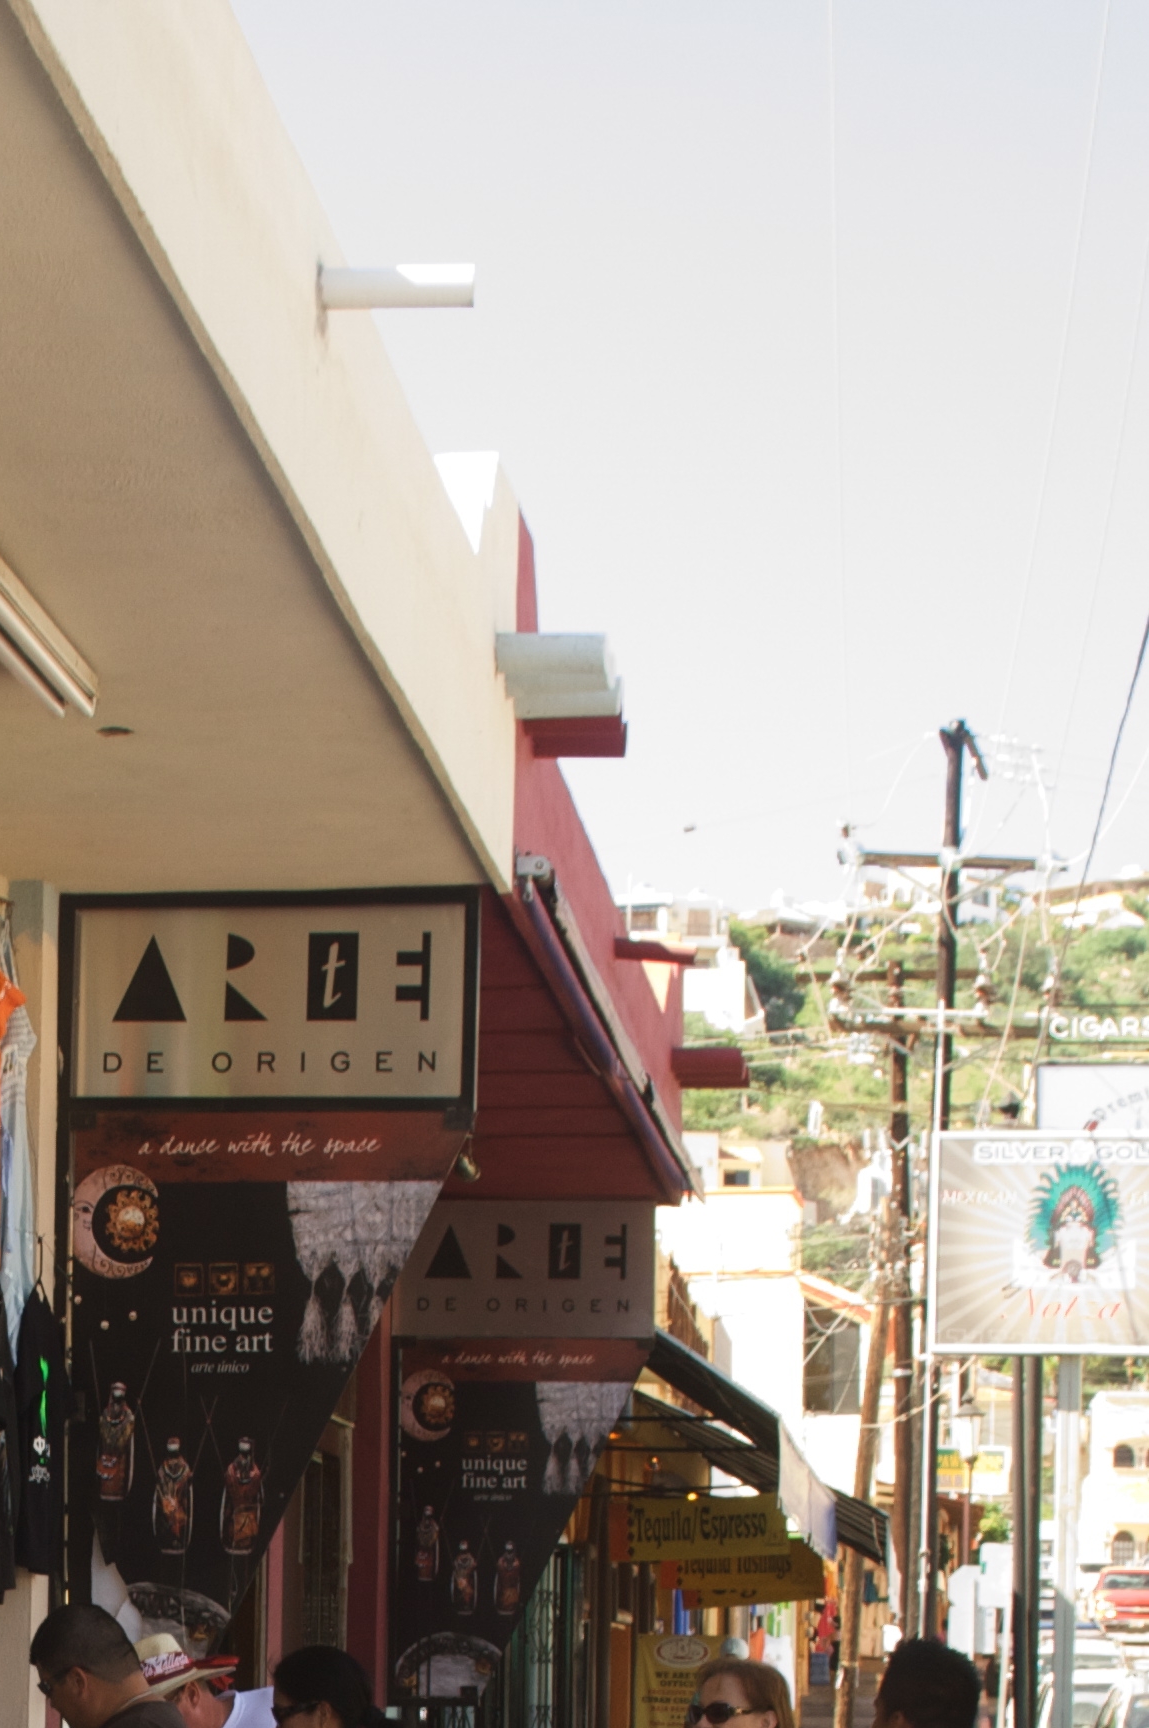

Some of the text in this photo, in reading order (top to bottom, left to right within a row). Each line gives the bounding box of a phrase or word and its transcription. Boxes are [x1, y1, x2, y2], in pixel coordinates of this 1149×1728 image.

[103, 1051, 437, 1074] DE ORIGEN
[138, 1131, 382, 1160] a dance with the space
[979, 1145, 1065, 1160] SILVER
[417, 1297, 629, 1313] DE ORIGEN
[172, 1300, 274, 1332] unique
[171, 1328, 273, 1353] fine art
[191, 1362, 214, 1374] arte
[461, 1454, 528, 1474] unique
[461, 1471, 527, 1489] fine art
